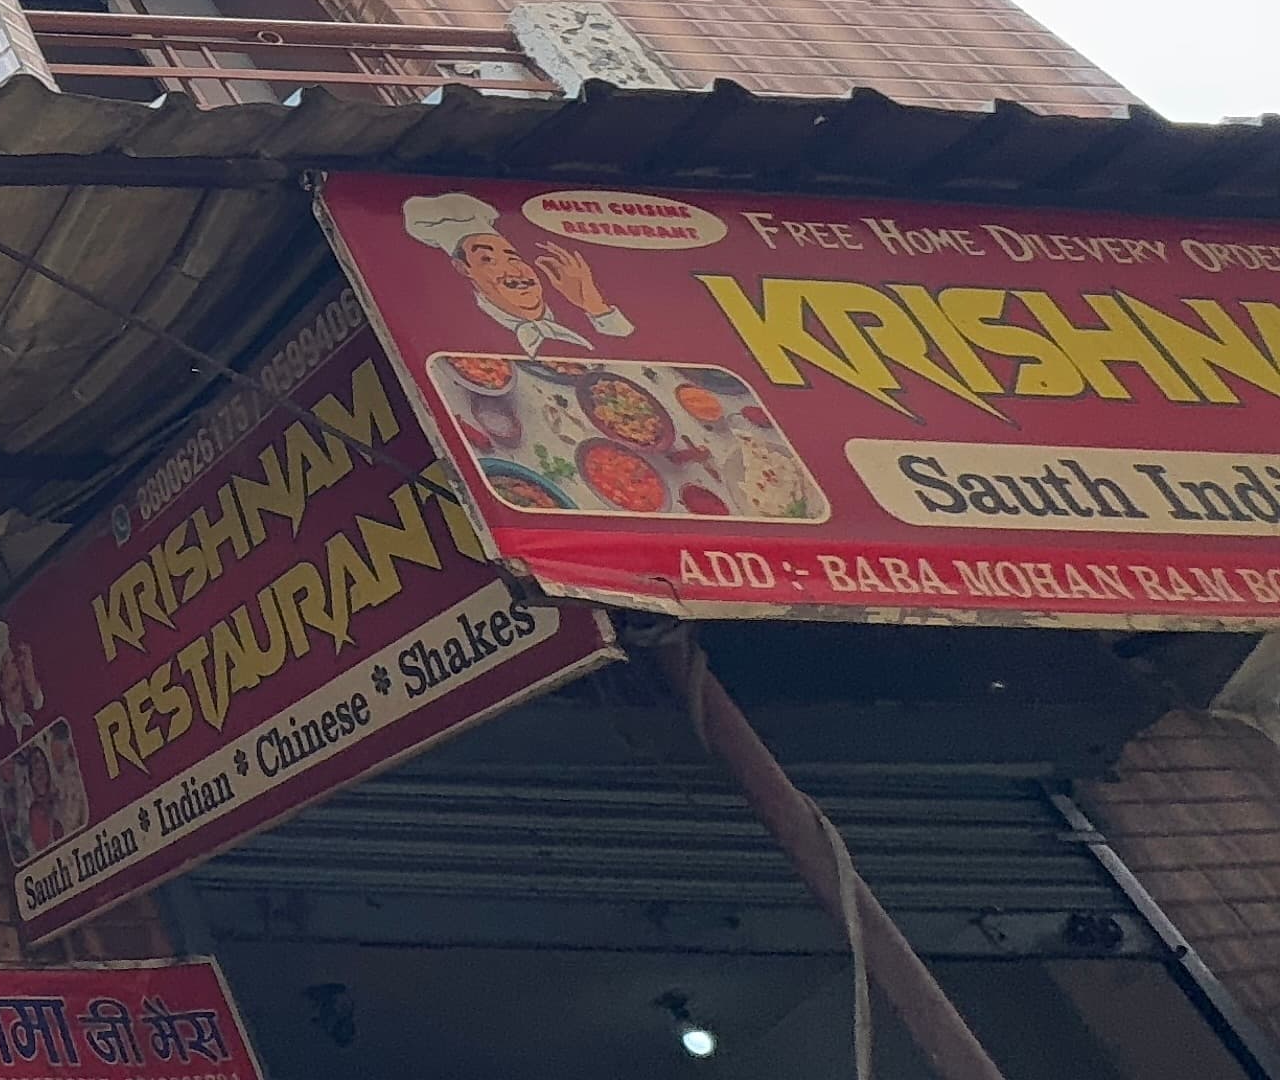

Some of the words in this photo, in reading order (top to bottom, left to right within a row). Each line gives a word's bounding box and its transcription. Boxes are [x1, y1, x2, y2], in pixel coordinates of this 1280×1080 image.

[542, 199, 603, 215] MULTI
[608, 202, 692, 219] CUISINE
[562, 220, 699, 241] RESTAURANT
[740, 211, 864, 251] FREE
[859, 218, 985, 257] HOME
[980, 224, 1169, 265] DILEVERY
[1180, 238, 1280, 273] ORDE
[91, 358, 401, 662] KRISHNAM
[897, 454, 1150, 520] Sauth
[678, 549, 777, 591] ADD
[817, 554, 961, 596] BABA
[952, 559, 1135, 601] MOHAN
[1127, 564, 1246, 603] RAM
[72, 827, 139, 883] Indian
[153, 771, 235, 837] Indian
[255, 692, 372, 777] Chinese
[398, 602, 536, 699] Shakes
[77, 998, 143, 1065] जी
[142, 995, 232, 1063] मैस
